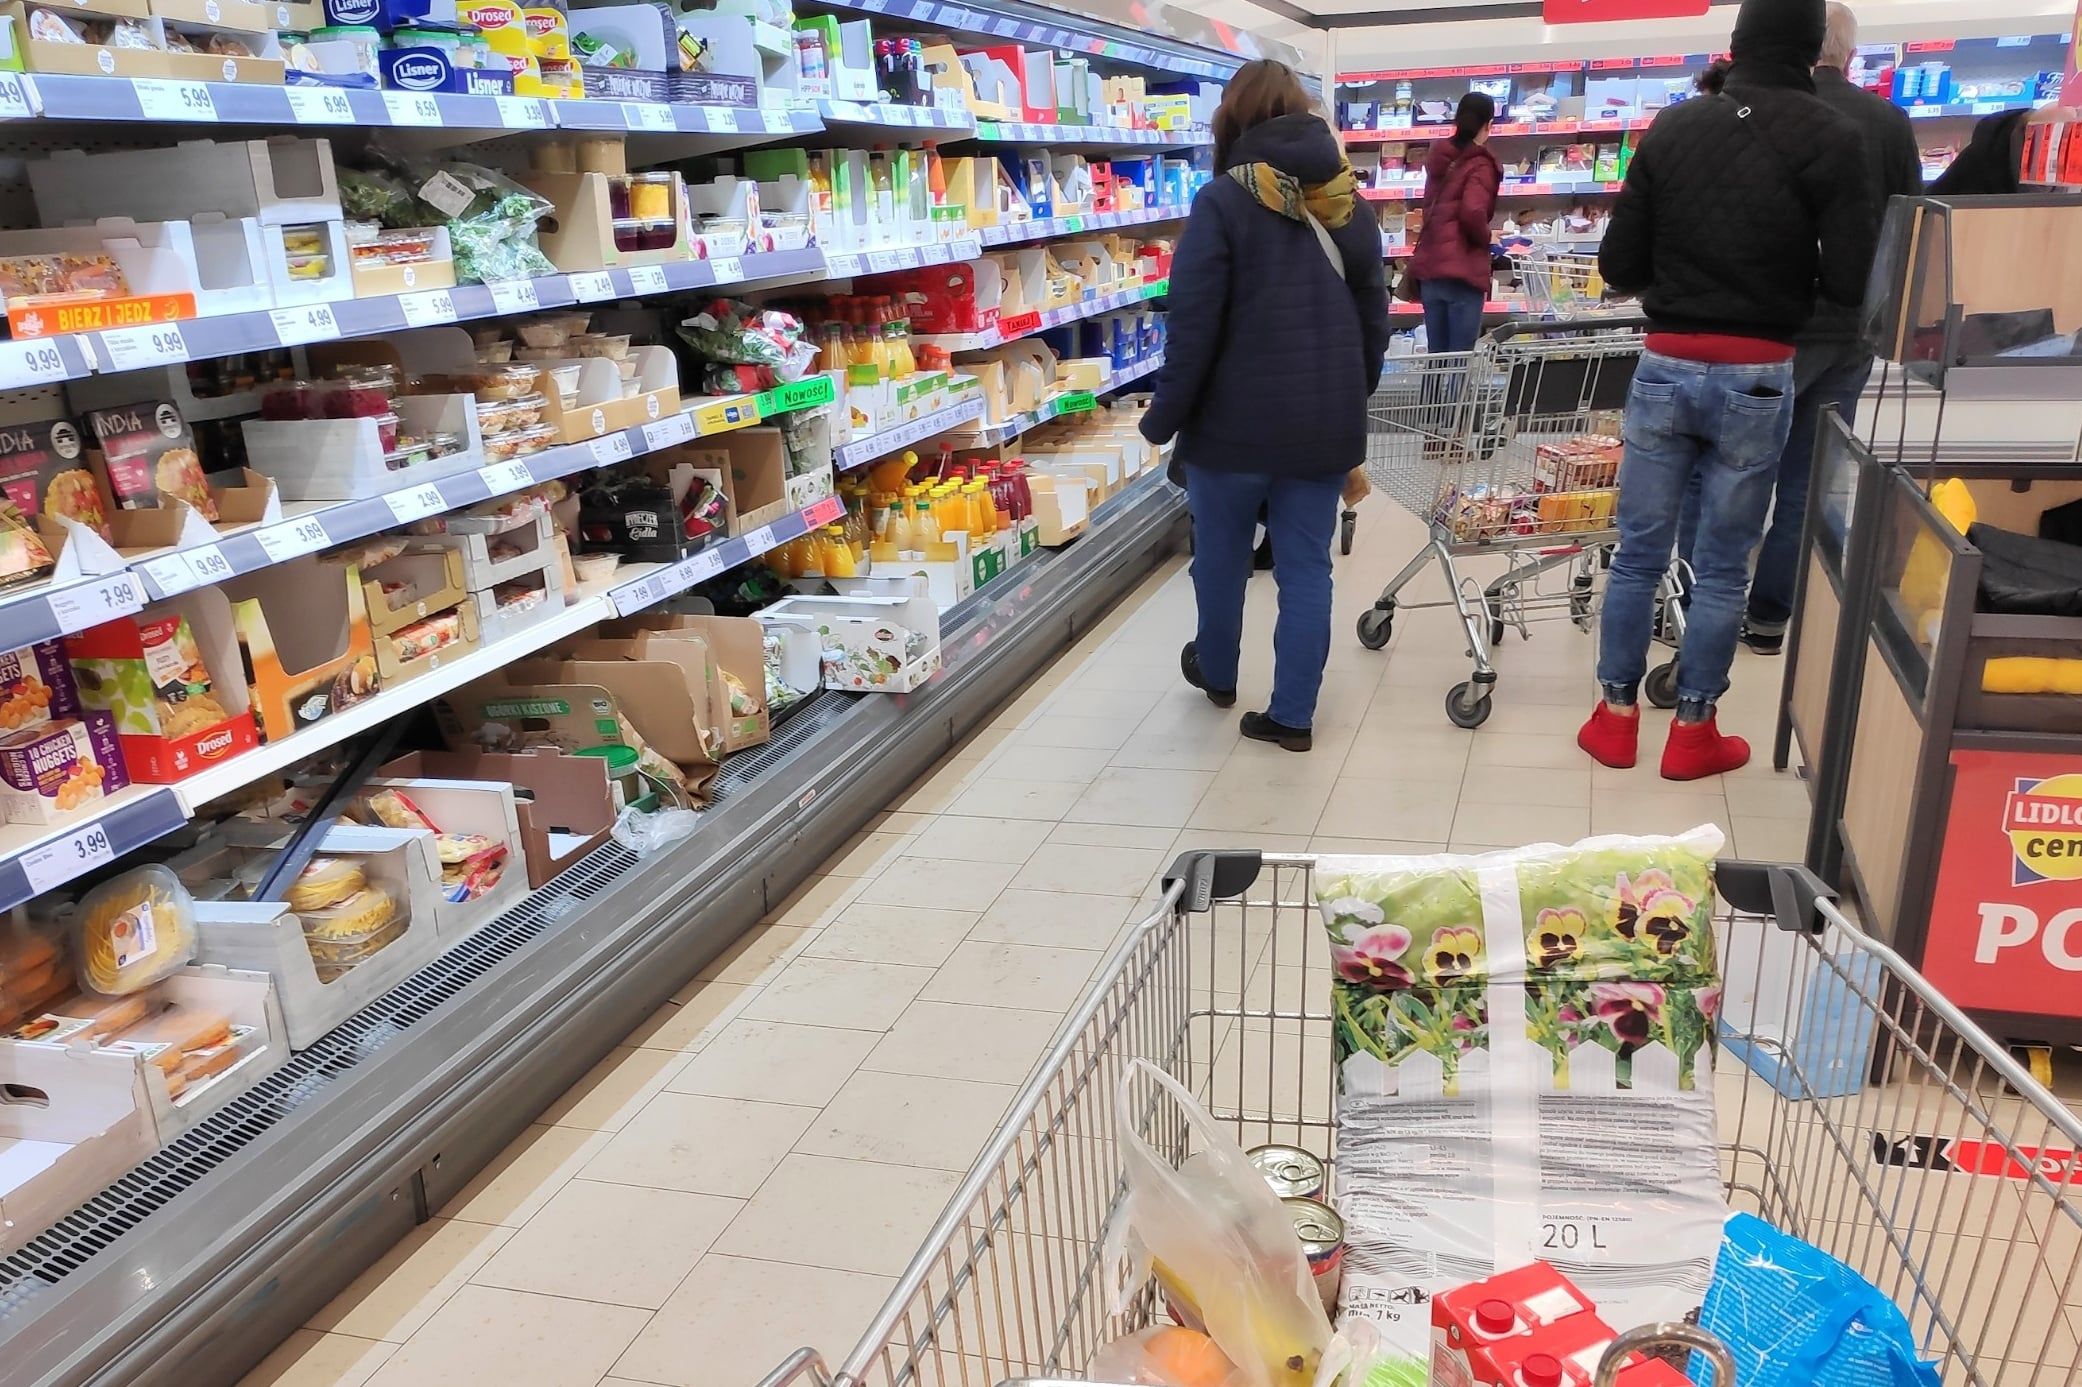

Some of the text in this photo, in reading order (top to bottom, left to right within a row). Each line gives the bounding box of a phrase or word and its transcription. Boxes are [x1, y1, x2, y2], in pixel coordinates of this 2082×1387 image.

[472, 9, 512, 22] Drosed
[526, 16, 556, 29] rosed
[399, 63, 439, 77] Lisner
[467, 71, 503, 95] Lisner
[180, 87, 211, 108] 5.99
[323, 95, 349, 113] 6.99
[415, 100, 438, 117] 6.59
[524, 104, 543, 121] 3.39
[432, 296, 453, 314] 5.99
[517, 287, 537, 304] 4.49
[58, 301, 152, 331] BIERZ I JEDZ
[308, 309, 332, 328] 4.99
[152, 332, 184, 354] 9.99
[25, 348, 61, 372] 9.99
[96, 411, 143, 437] INDIA
[508, 464, 530, 482] 3.99
[417, 490, 441, 508] 2.99
[296, 522, 324, 543] 3.69
[196, 554, 227, 577] 9.99
[100, 583, 134, 608] 7.99
[633, 585, 649, 602] 7.99
[521, 702, 563, 716] KISZONE
[29, 733, 73, 760] 10 CHICKEN
[197, 730, 233, 755] Drosed
[32, 748, 77, 774] NUGGETS
[75, 831, 106, 858] 3.99
[1542, 1223, 1606, 1248] 20 L
[1376, 1310, 1383, 1320] 7
[1386, 1310, 1401, 1321] kg
